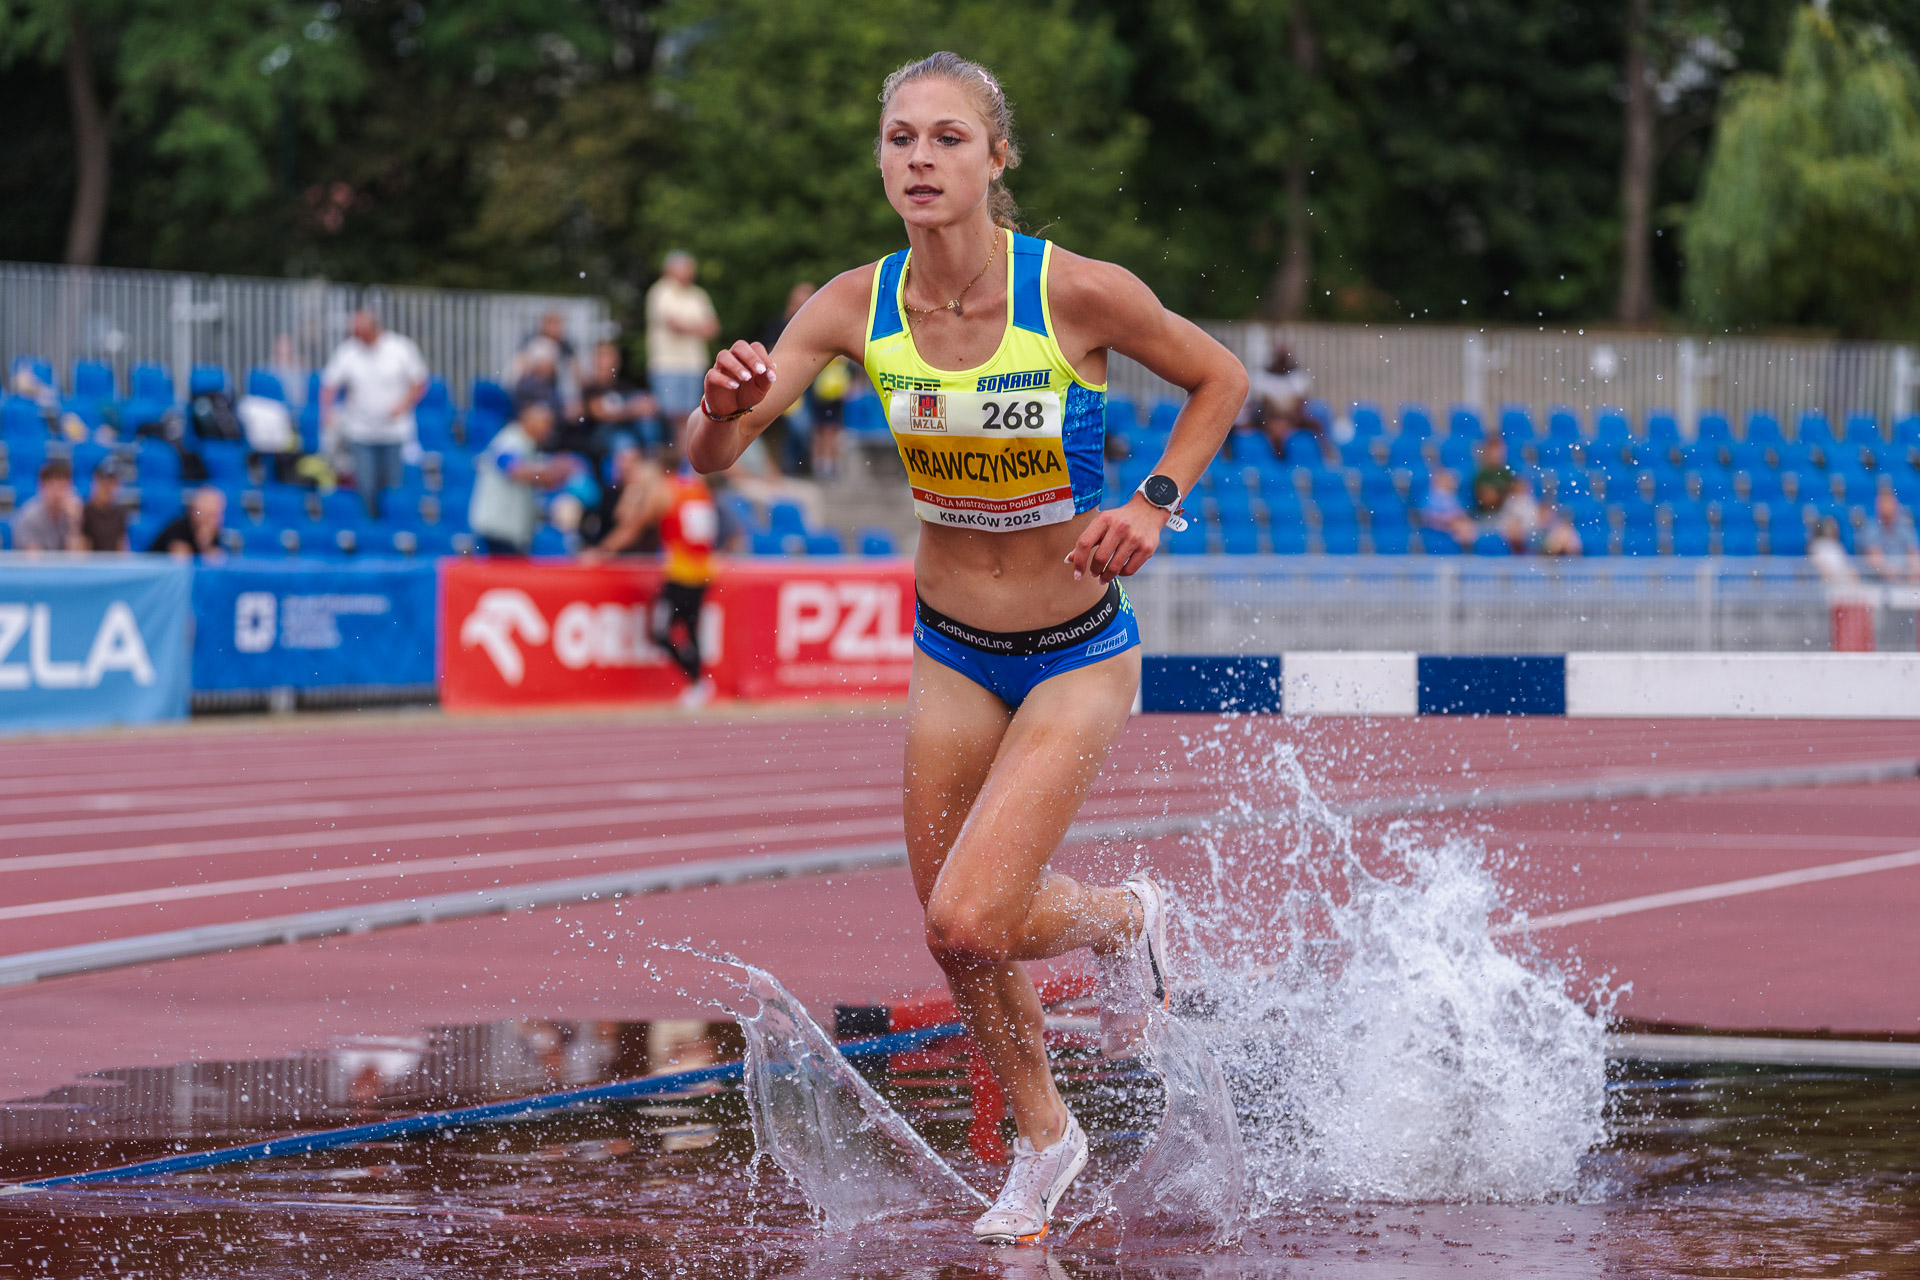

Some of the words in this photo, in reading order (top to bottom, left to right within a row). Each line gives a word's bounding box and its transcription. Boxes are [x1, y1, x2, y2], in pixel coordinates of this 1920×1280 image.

[976, 369, 1052, 393] SONAROL
[912, 418, 945, 430] MZLA
[981, 401, 1045, 430] 268
[903, 447, 1062, 483] KRAWCZYŃSKA
[924, 493, 935, 503] 42.
[936, 497, 954, 507] PZLA
[956, 499, 1007, 511] Mistrzostwa
[1009, 497, 1037, 510] Polski
[1038, 492, 1056, 503] U23
[939, 511, 1000, 528] KRAKÓW
[1004, 511, 1041, 527] 2025
